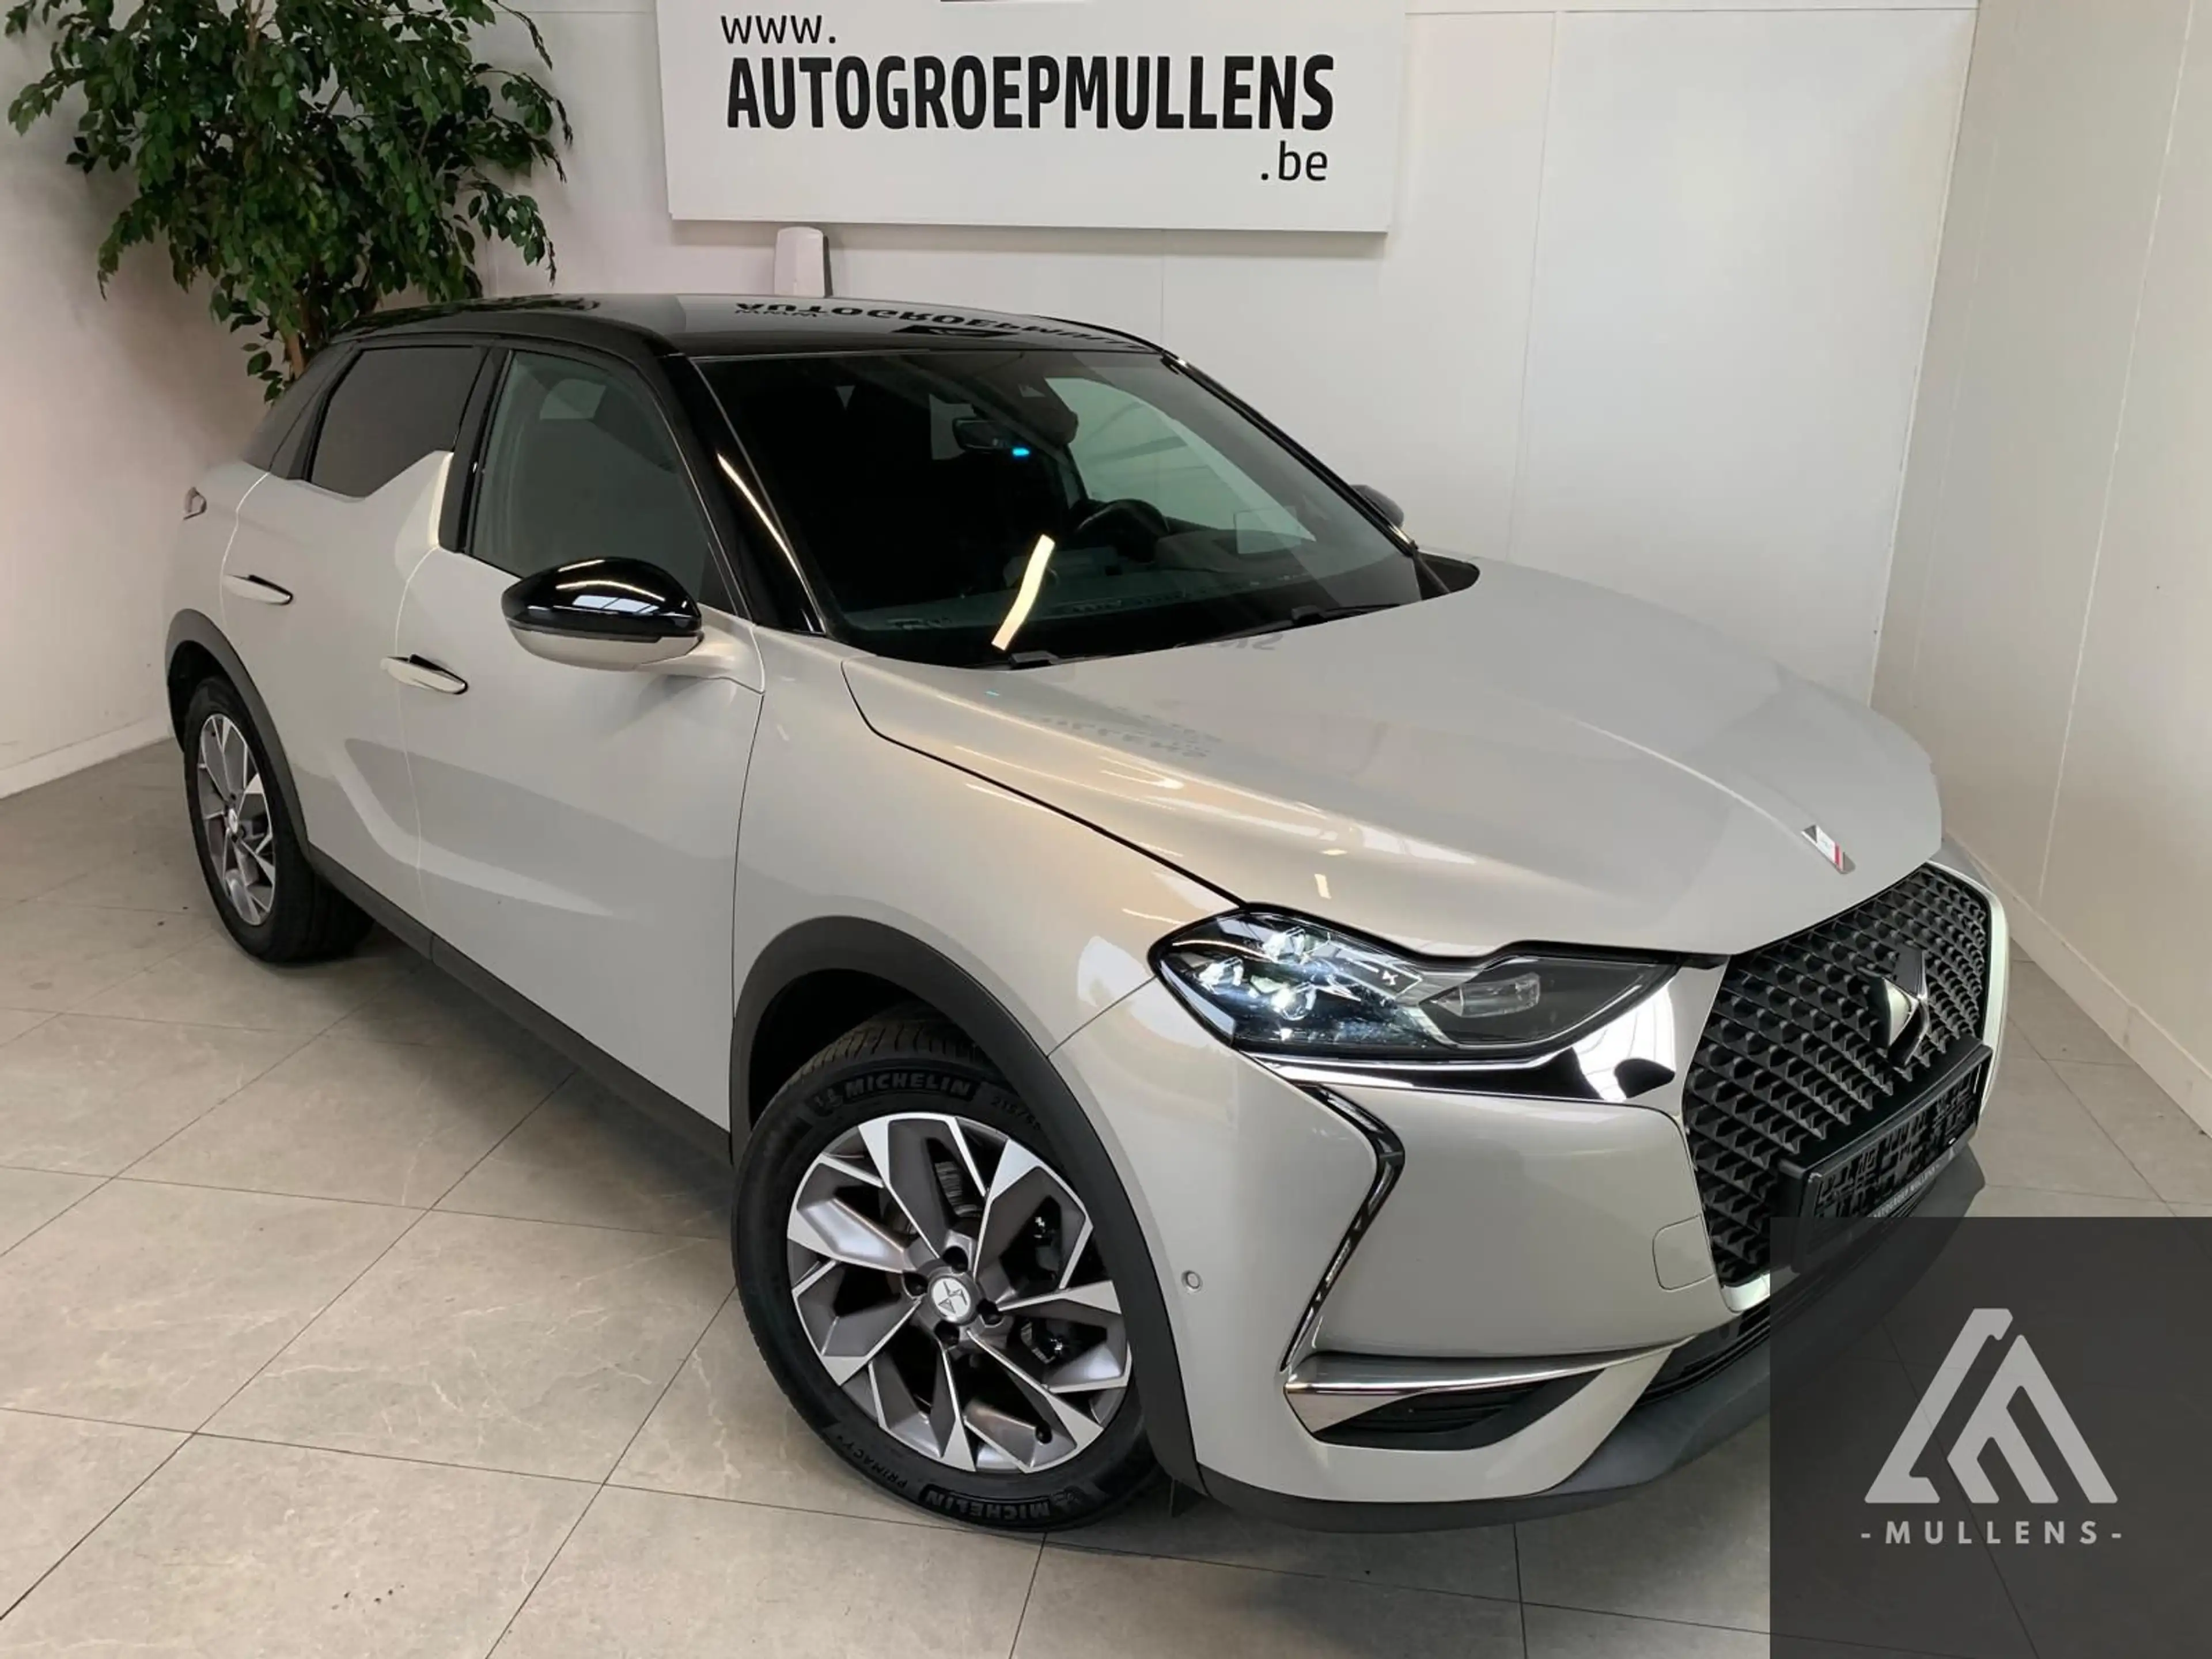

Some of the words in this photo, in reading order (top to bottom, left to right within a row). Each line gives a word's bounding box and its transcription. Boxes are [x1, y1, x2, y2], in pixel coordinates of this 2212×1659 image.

[721, 16, 835, 44] www.
[728, 55, 1333, 130] AUTOGROEPMULLENS
[1262, 141, 1327, 181] .be
[846, 1073, 971, 1099] MICHELIN
[842, 1440, 908, 1489] PRIMACY
[926, 1490, 1051, 1520] MICHELIN
